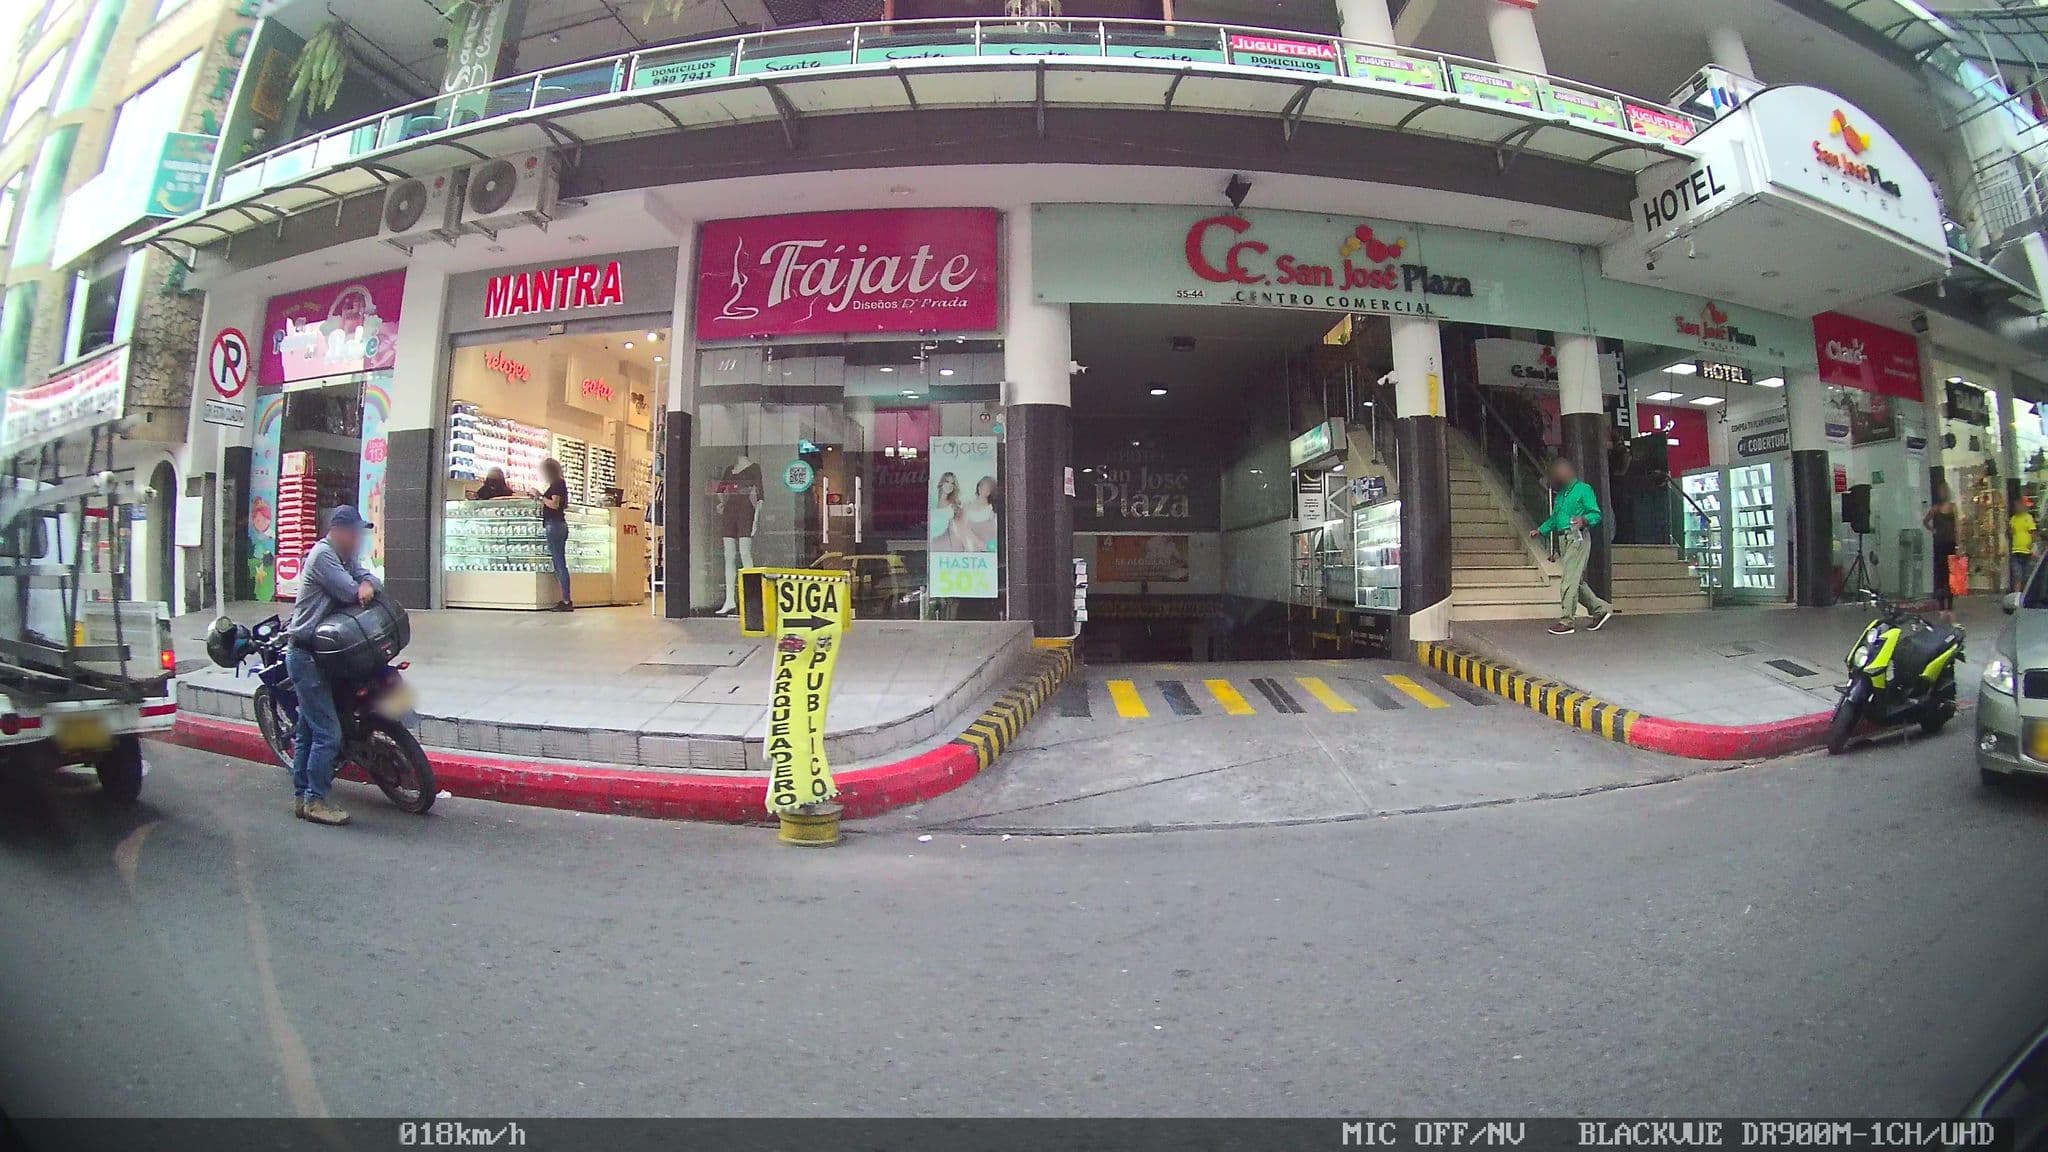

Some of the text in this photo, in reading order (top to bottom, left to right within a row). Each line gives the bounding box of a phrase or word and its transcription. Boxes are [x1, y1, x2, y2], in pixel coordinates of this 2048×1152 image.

[651, 61, 716, 77] DOMICILIOS
[1251, 56, 1321, 70] DOMICILIOS
[1645, 165, 1726, 233] HOTEL
[484, 260, 624, 319] MANTRA
[760, 239, 979, 313] Fájate
[1275, 254, 1334, 288] San
[1400, 263, 1474, 298] Plaza
[920, 297, 968, 309] Prada
[1176, 289, 1204, 299] 55-44
[1235, 290, 1434, 316] CENTRO COMERCIAL
[1613, 350, 1630, 428] HOTE
[1703, 361, 1749, 384] HOTEL
[1095, 482, 1192, 518] Plaza
[938, 556, 988, 569] HASTA
[779, 581, 838, 613] SIGA
[769, 653, 798, 807] PARQUEADERO
[805, 651, 828, 797] PUBLICO
